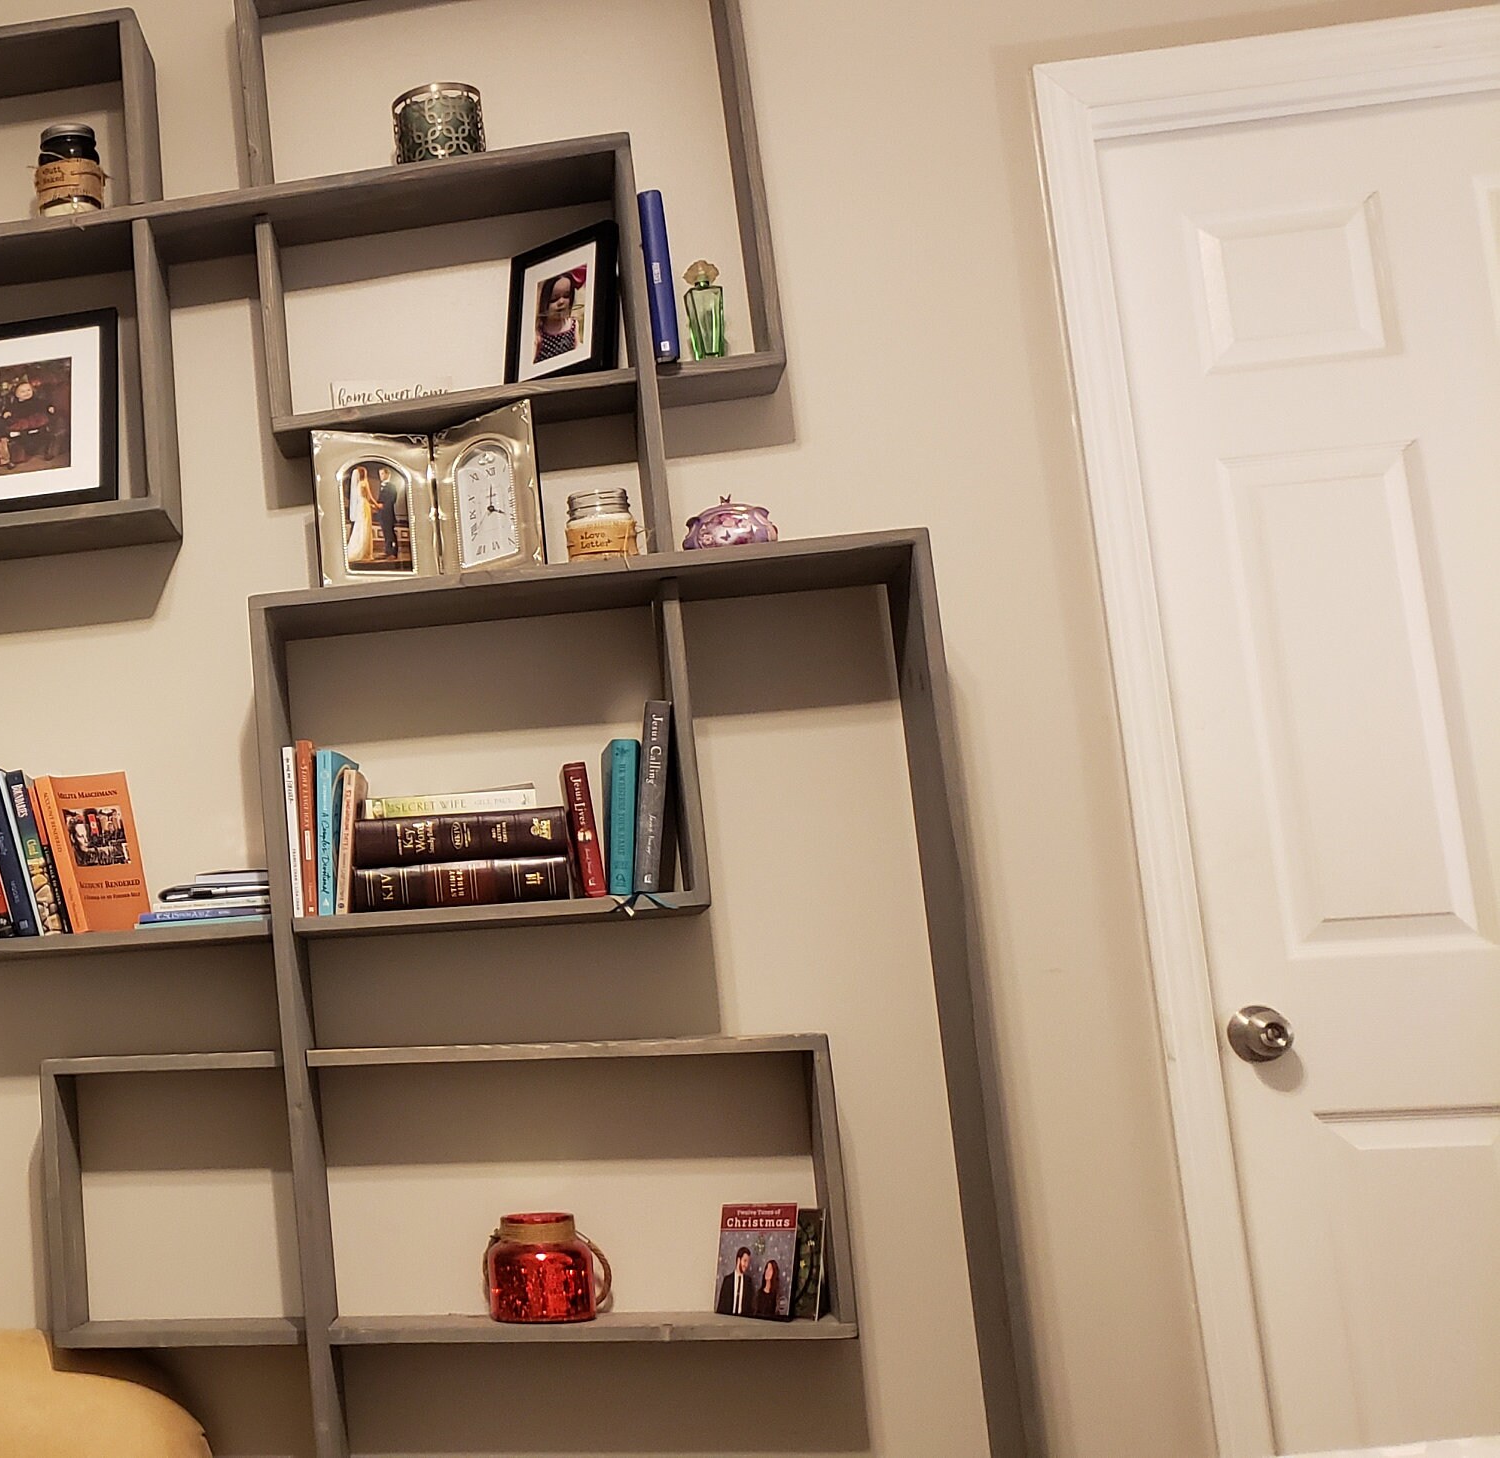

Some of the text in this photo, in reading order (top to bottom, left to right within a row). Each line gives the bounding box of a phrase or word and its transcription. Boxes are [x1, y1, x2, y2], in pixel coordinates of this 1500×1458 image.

[581, 540, 610, 549] Letter
[584, 531, 606, 540] Love
[645, 714, 663, 784] Jesus Calling
[57, 791, 77, 799] MELITA
[395, 798, 437, 812] SECRET
[440, 799, 467, 810] WIFE
[569, 774, 589, 826] Jesus Lives
[10, 782, 39, 856] BOUNDARIES Cloud
[42, 792, 62, 853] ACCOUNT RENDERED
[319, 820, 329, 853] Couple's
[400, 827, 416, 848] Key
[412, 821, 426, 853] Word
[80, 879, 140, 889] ACCOUNT RENDERED
[320, 856, 330, 895] Devotional
[380, 872, 393, 900] KJV
[447, 870, 458, 897] STUDY
[455, 868, 465, 896] BIBLE
[726, 1217, 790, 1228] Christmas
